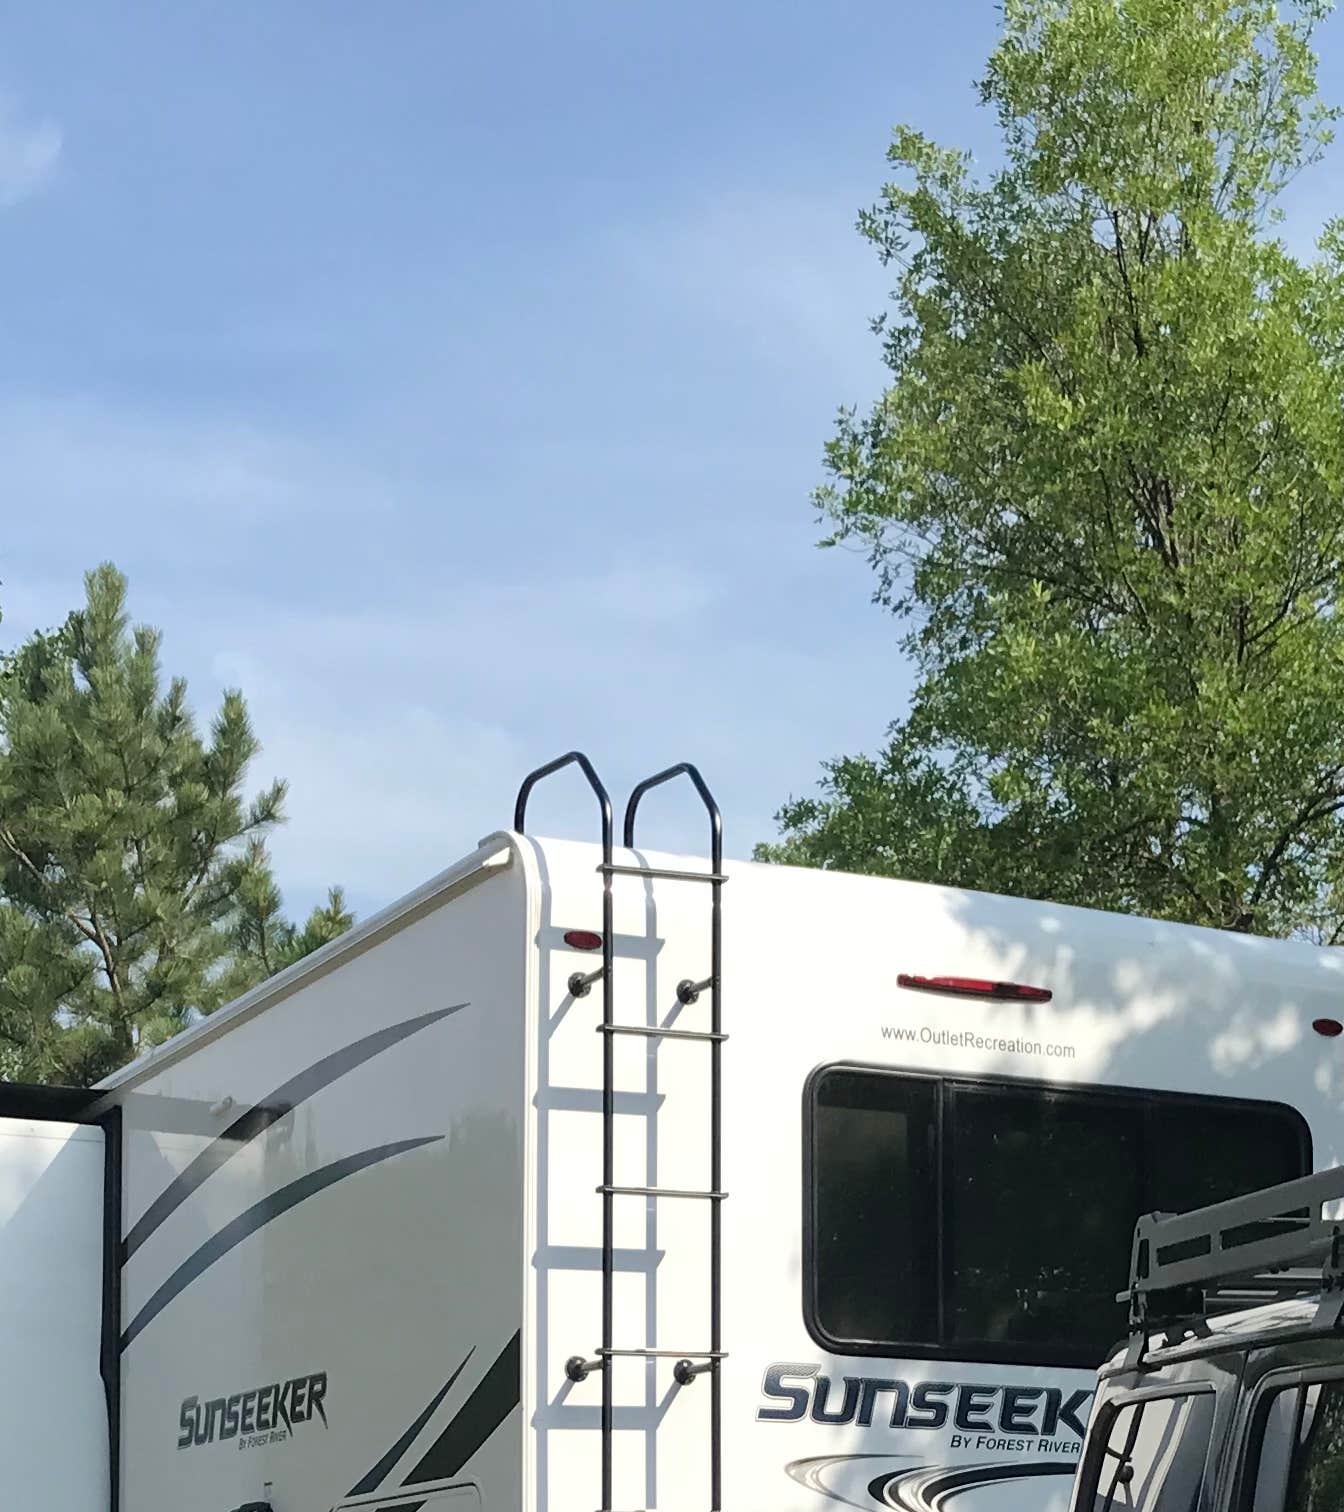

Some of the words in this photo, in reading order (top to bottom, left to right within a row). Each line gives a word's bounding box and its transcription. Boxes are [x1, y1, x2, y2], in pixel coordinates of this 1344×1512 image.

[881, 1026, 1075, 1058] www.OutletRecreation.com
[177, 1371, 328, 1450] SUNSEEKER
[755, 1361, 1096, 1440] SUNSEEK
[976, 1436, 1034, 1452] FOREST
[1037, 1438, 1081, 1453] RIVER
